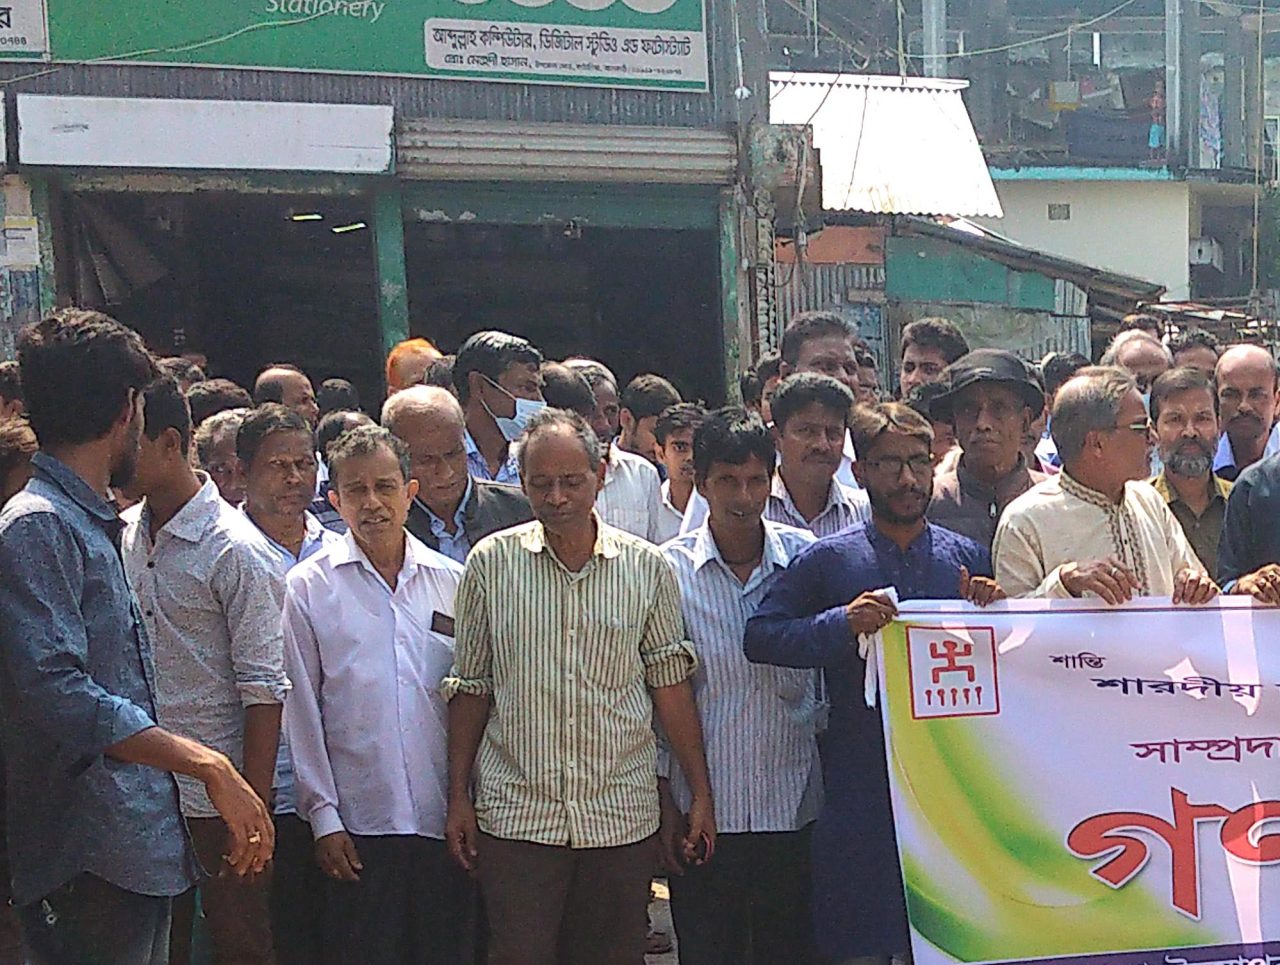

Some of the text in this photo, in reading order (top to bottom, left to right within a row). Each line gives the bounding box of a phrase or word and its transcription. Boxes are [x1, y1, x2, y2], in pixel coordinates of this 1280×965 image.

[266, 0, 386, 23] Stationery
[539, 28, 584, 51] ডিজিটাল
[1049, 652, 1108, 671] শান্তি
[1096, 674, 1262, 700] শারদীয়
